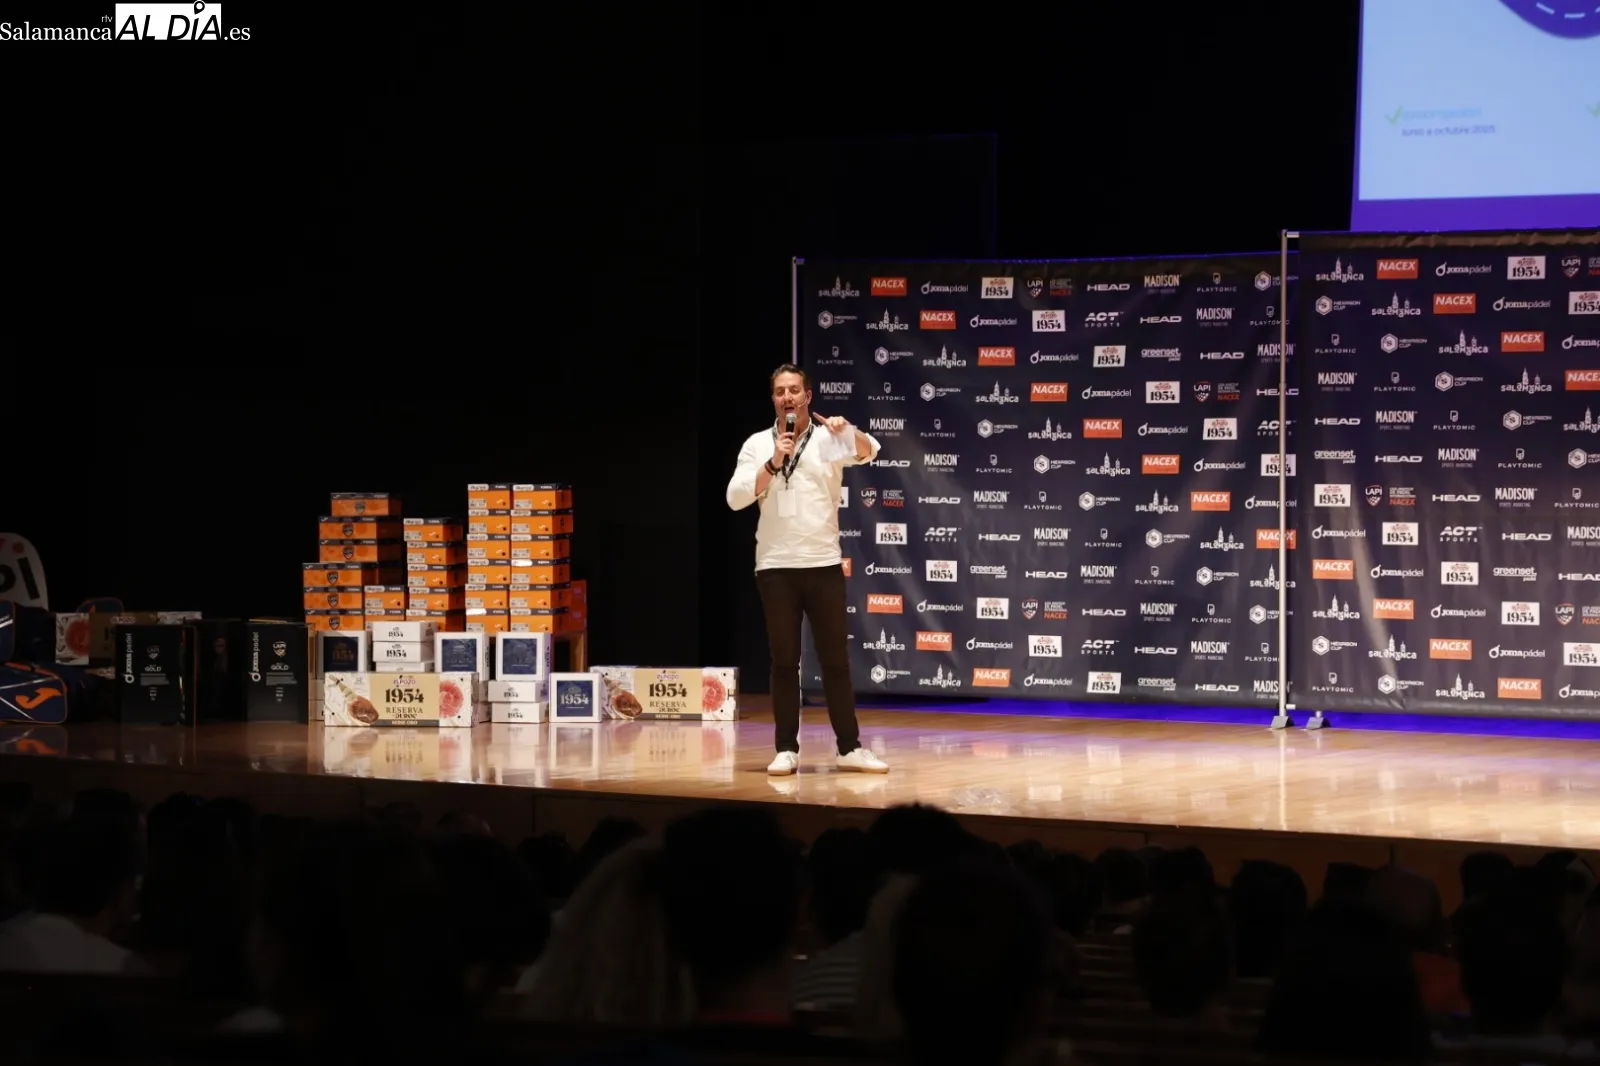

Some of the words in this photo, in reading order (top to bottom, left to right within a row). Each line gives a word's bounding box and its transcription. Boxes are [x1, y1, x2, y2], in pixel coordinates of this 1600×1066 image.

[1379, 261, 1416, 270] NACEX
[1512, 266, 1540, 277] 1954
[872, 280, 904, 288] NACEX
[1144, 275, 1180, 287] MADISON
[985, 286, 1009, 296] 1954
[1435, 296, 1473, 305] NACEX
[921, 313, 954, 321] NACEX
[1085, 312, 1119, 321] ACT
[1196, 308, 1232, 320] MADISON
[1036, 318, 1061, 331] 1954
[1504, 334, 1541, 344] NACEX
[979, 349, 1012, 358] NACEX
[1097, 356, 1121, 366] 1954
[1318, 372, 1354, 385] MADISON
[820, 382, 852, 393] MADISON
[1033, 385, 1065, 395] NACEX
[1150, 391, 1175, 401] 1954
[1376, 410, 1414, 423] MADISON
[870, 418, 904, 430] MADISON
[1085, 421, 1120, 430] NACEX
[1206, 427, 1233, 438] 1954
[1438, 448, 1476, 460] MADISON
[924, 454, 957, 465] MADISON
[1144, 457, 1177, 466] NACEX
[974, 491, 1007, 502] MADISON
[1193, 493, 1228, 502] NACEX
[1495, 488, 1534, 500] MADISON
[1319, 494, 1347, 505] 1954
[925, 528, 957, 536] ACT
[1034, 528, 1068, 540] MADISON
[1441, 527, 1476, 536] ACT
[880, 532, 903, 542] 1954
[1386, 531, 1414, 543] 1954
[1081, 566, 1114, 577] MADISON
[1315, 562, 1350, 571] NACEX
[930, 569, 953, 579] 1954
[1446, 572, 1473, 583] 1954
[868, 597, 900, 605] NACEX
[1375, 601, 1411, 610] NACEX
[981, 607, 1004, 617] 1954
[1141, 603, 1174, 615] MADISON
[1506, 611, 1535, 623] 1954
[918, 634, 949, 642] NACEX
[1082, 640, 1115, 648] ACT
[1191, 641, 1227, 653] MADISON
[1432, 641, 1469, 651] NACEX
[1033, 644, 1058, 655] 1954
[1568, 652, 1597, 664] 1954
[975, 671, 1008, 679] NACEX
[649, 682, 688, 698] 1954
[1092, 681, 1116, 691] 1954
[1500, 681, 1538, 690] NACEX
[385, 688, 424, 703] 1954
[560, 693, 589, 705] 1954
